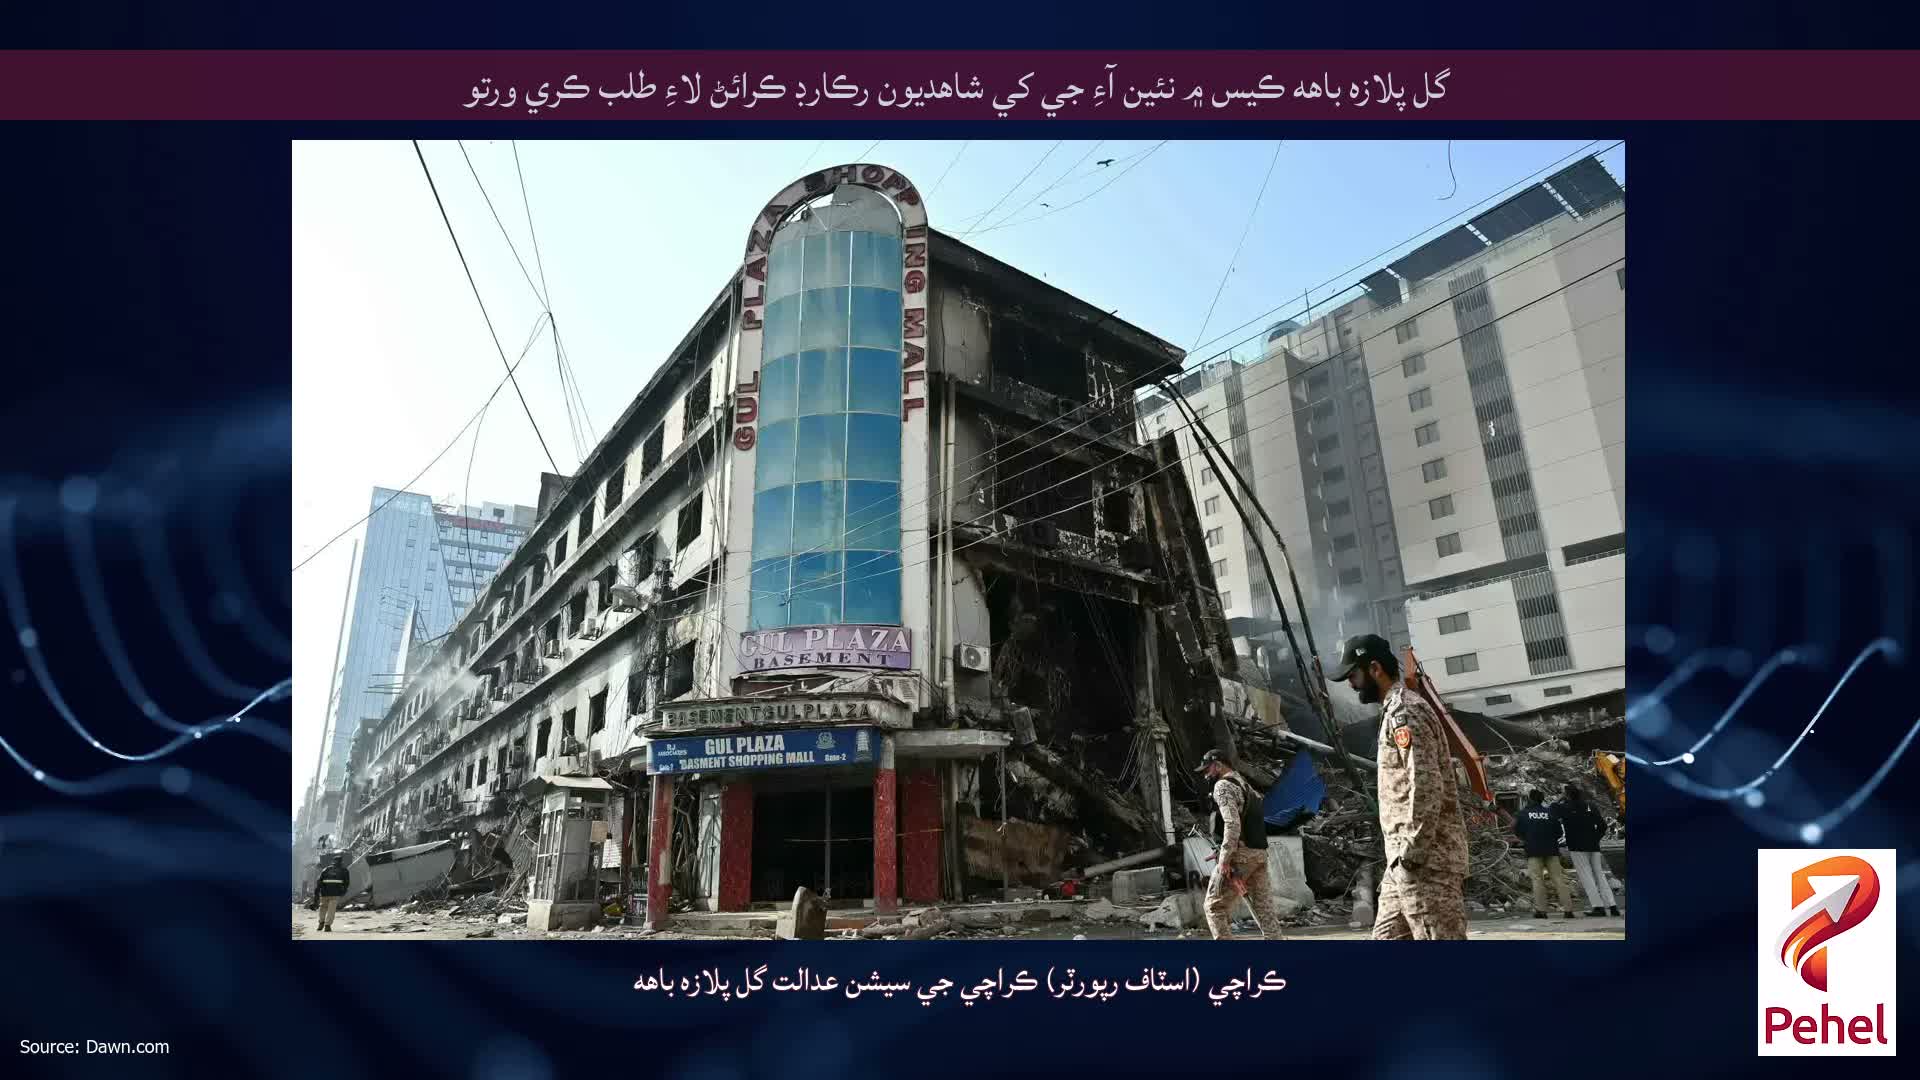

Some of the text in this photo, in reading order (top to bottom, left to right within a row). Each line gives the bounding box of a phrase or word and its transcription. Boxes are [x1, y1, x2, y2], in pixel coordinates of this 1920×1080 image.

[741, 204, 788, 331] PLAZA
[901, 307, 926, 423] MALL
[733, 370, 760, 452] GUL
[740, 628, 910, 657] GUL PLAZA
[754, 651, 890, 668] BASEMENT
[704, 733, 786, 756] GUL PLAZA
[728, 753, 784, 768] SHOPPING
[786, 751, 814, 763] MALL
[1528, 812, 1549, 820] POLICE
